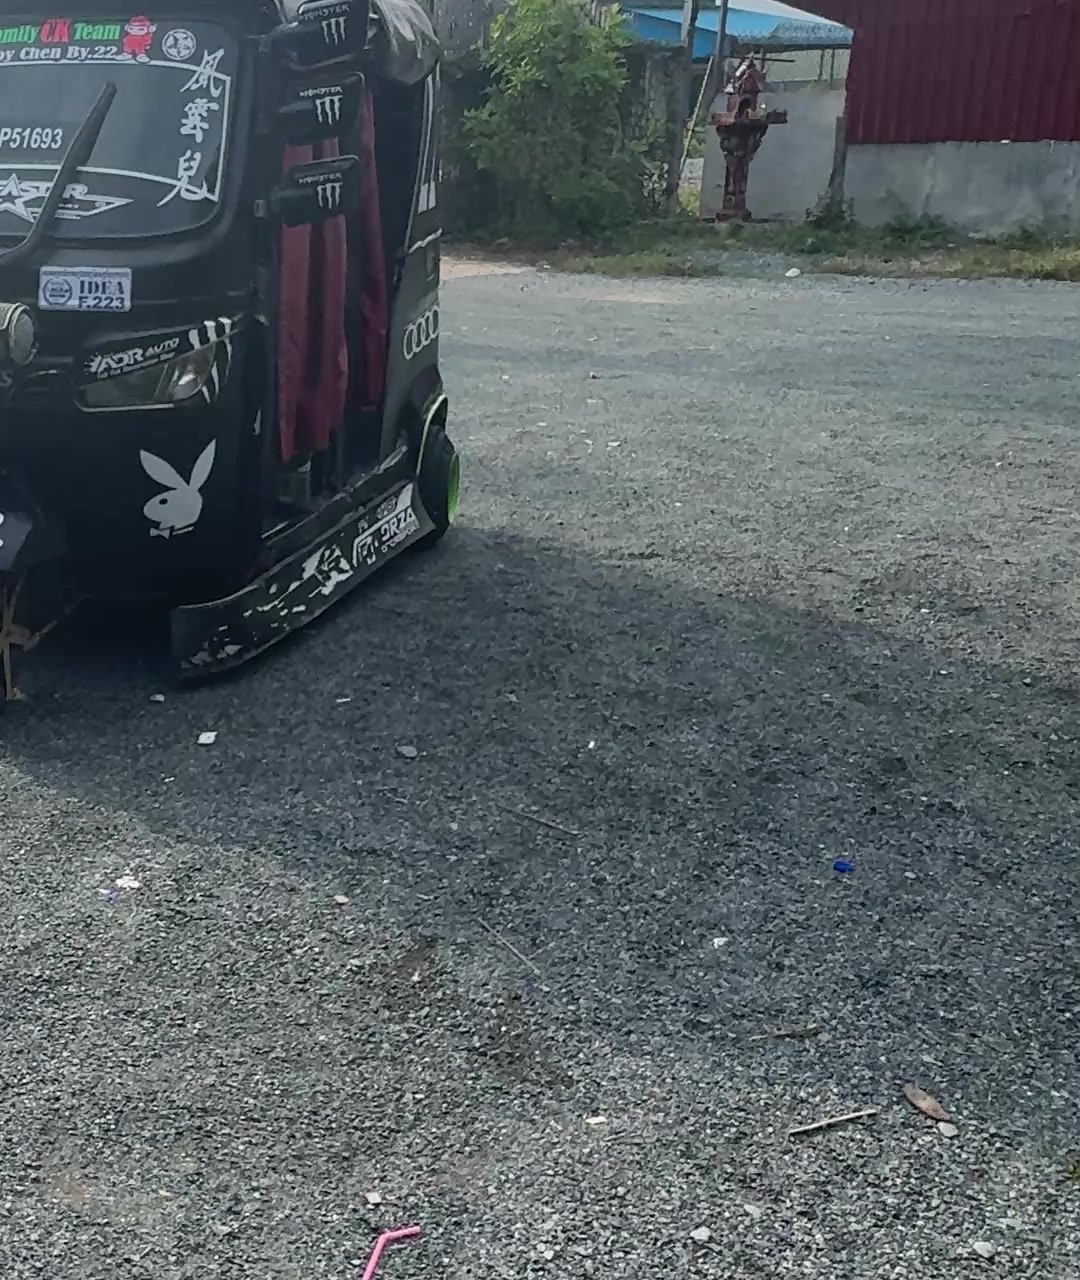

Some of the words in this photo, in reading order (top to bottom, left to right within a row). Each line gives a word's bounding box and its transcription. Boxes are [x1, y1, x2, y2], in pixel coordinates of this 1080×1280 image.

[74, 23, 121, 41] Team
[20, 46, 61, 61] Chen
[79, 280, 124, 296] IDEA
[78, 296, 124, 310] F.223
[145, 336, 180, 357] AUTO
